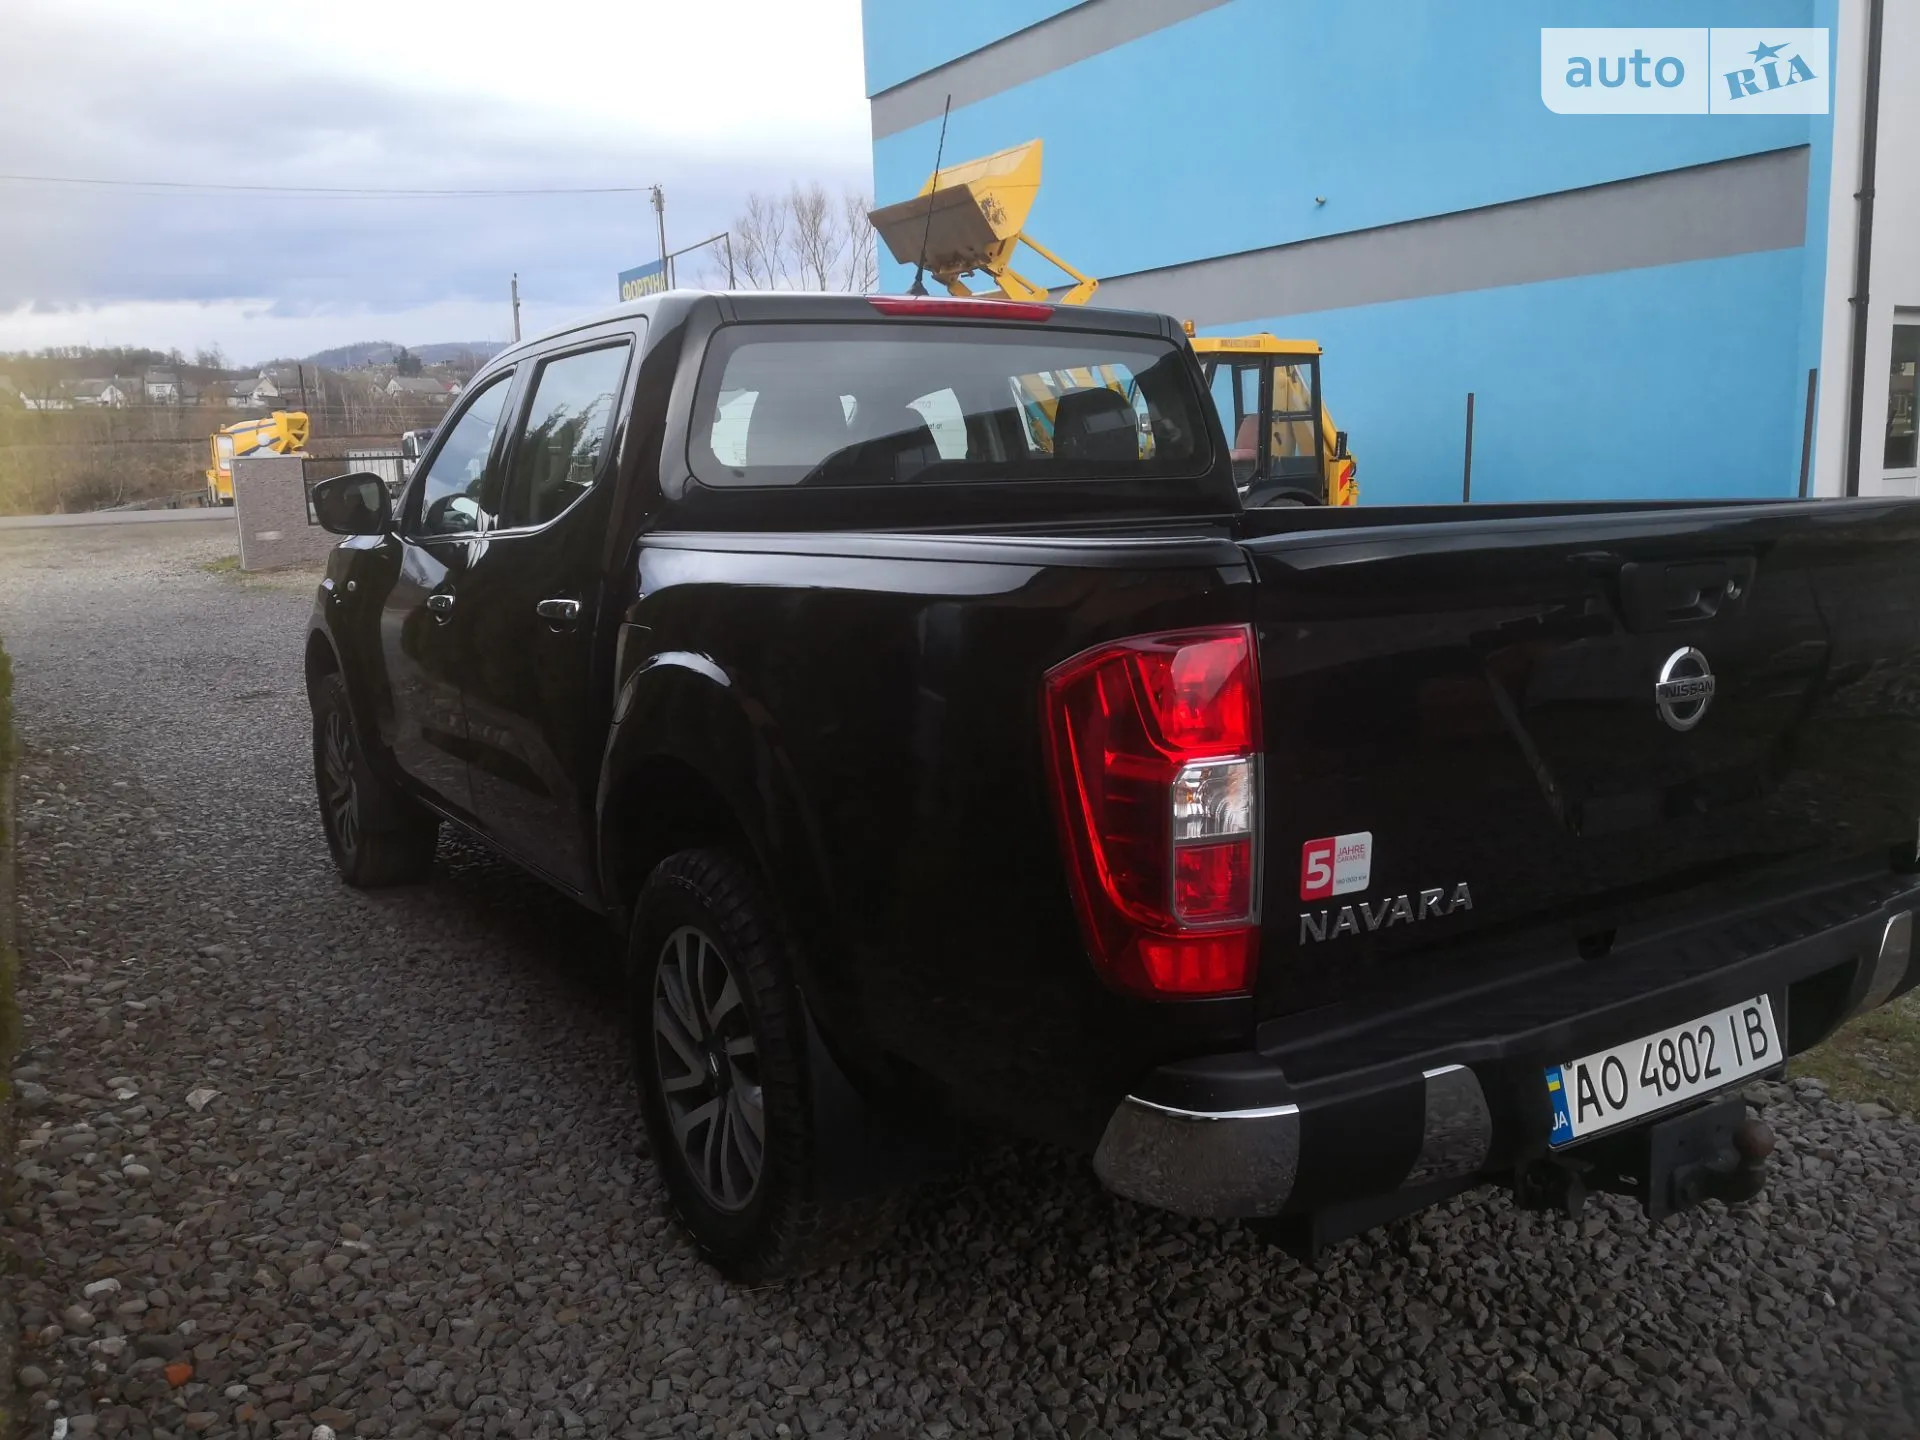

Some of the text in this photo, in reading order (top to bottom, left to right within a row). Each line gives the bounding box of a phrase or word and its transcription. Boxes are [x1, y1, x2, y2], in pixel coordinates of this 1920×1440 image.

[1664, 680, 1713, 698] NISSAN
[1306, 849, 1332, 890] 5
[1338, 844, 1365, 855] JAHRE
[1299, 882, 1473, 945] NAVARA
[1576, 1006, 1769, 1124] AO 4802 IB
